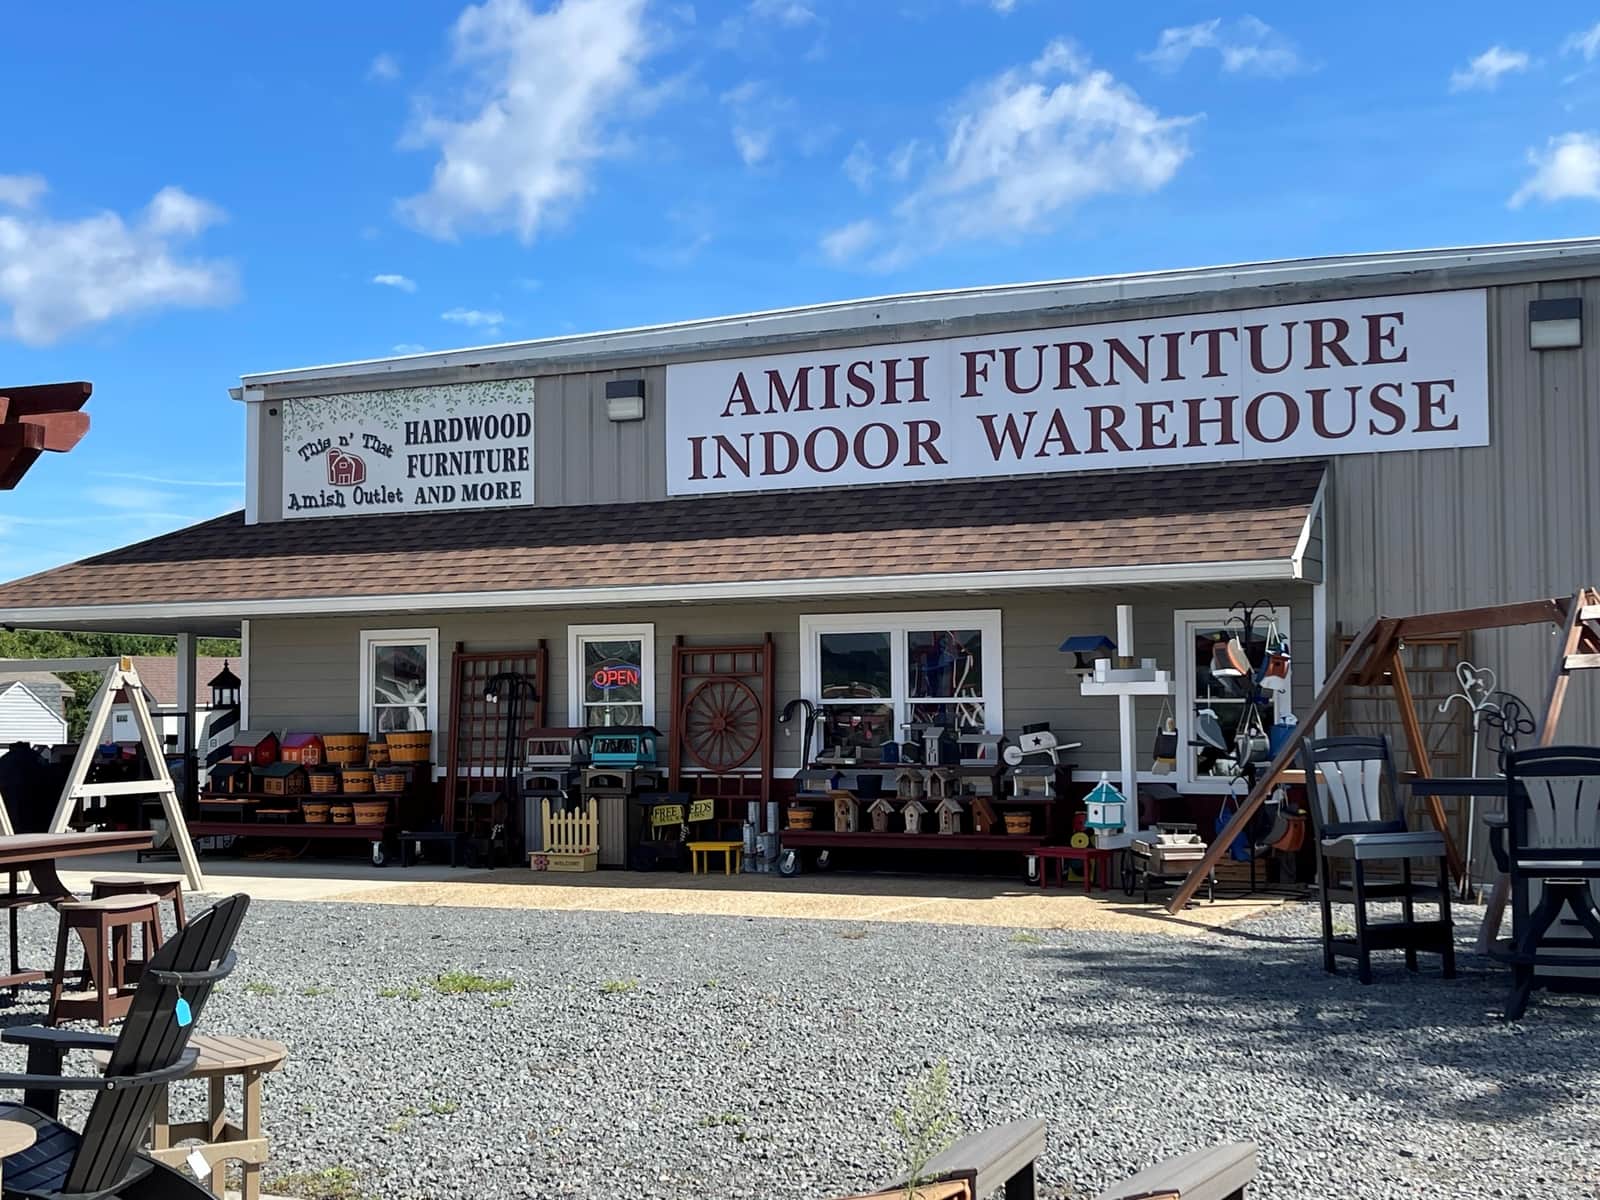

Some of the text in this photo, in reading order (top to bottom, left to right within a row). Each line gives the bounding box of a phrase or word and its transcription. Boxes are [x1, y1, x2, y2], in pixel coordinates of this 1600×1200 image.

[720, 311, 1408, 417] AMISH FURNITURE
[404, 412, 531, 445] HARDWOOD
[687, 379, 1459, 480] INDOOR WAREHOUSE
[298, 437, 331, 462] This
[362, 433, 393, 458] That
[407, 446, 529, 478] FURNITURE
[288, 485, 403, 510] Amish Outlet
[415, 481, 521, 504] AND MORE
[594, 670, 638, 686] OPEN
[655, 806, 677, 817] FREE
